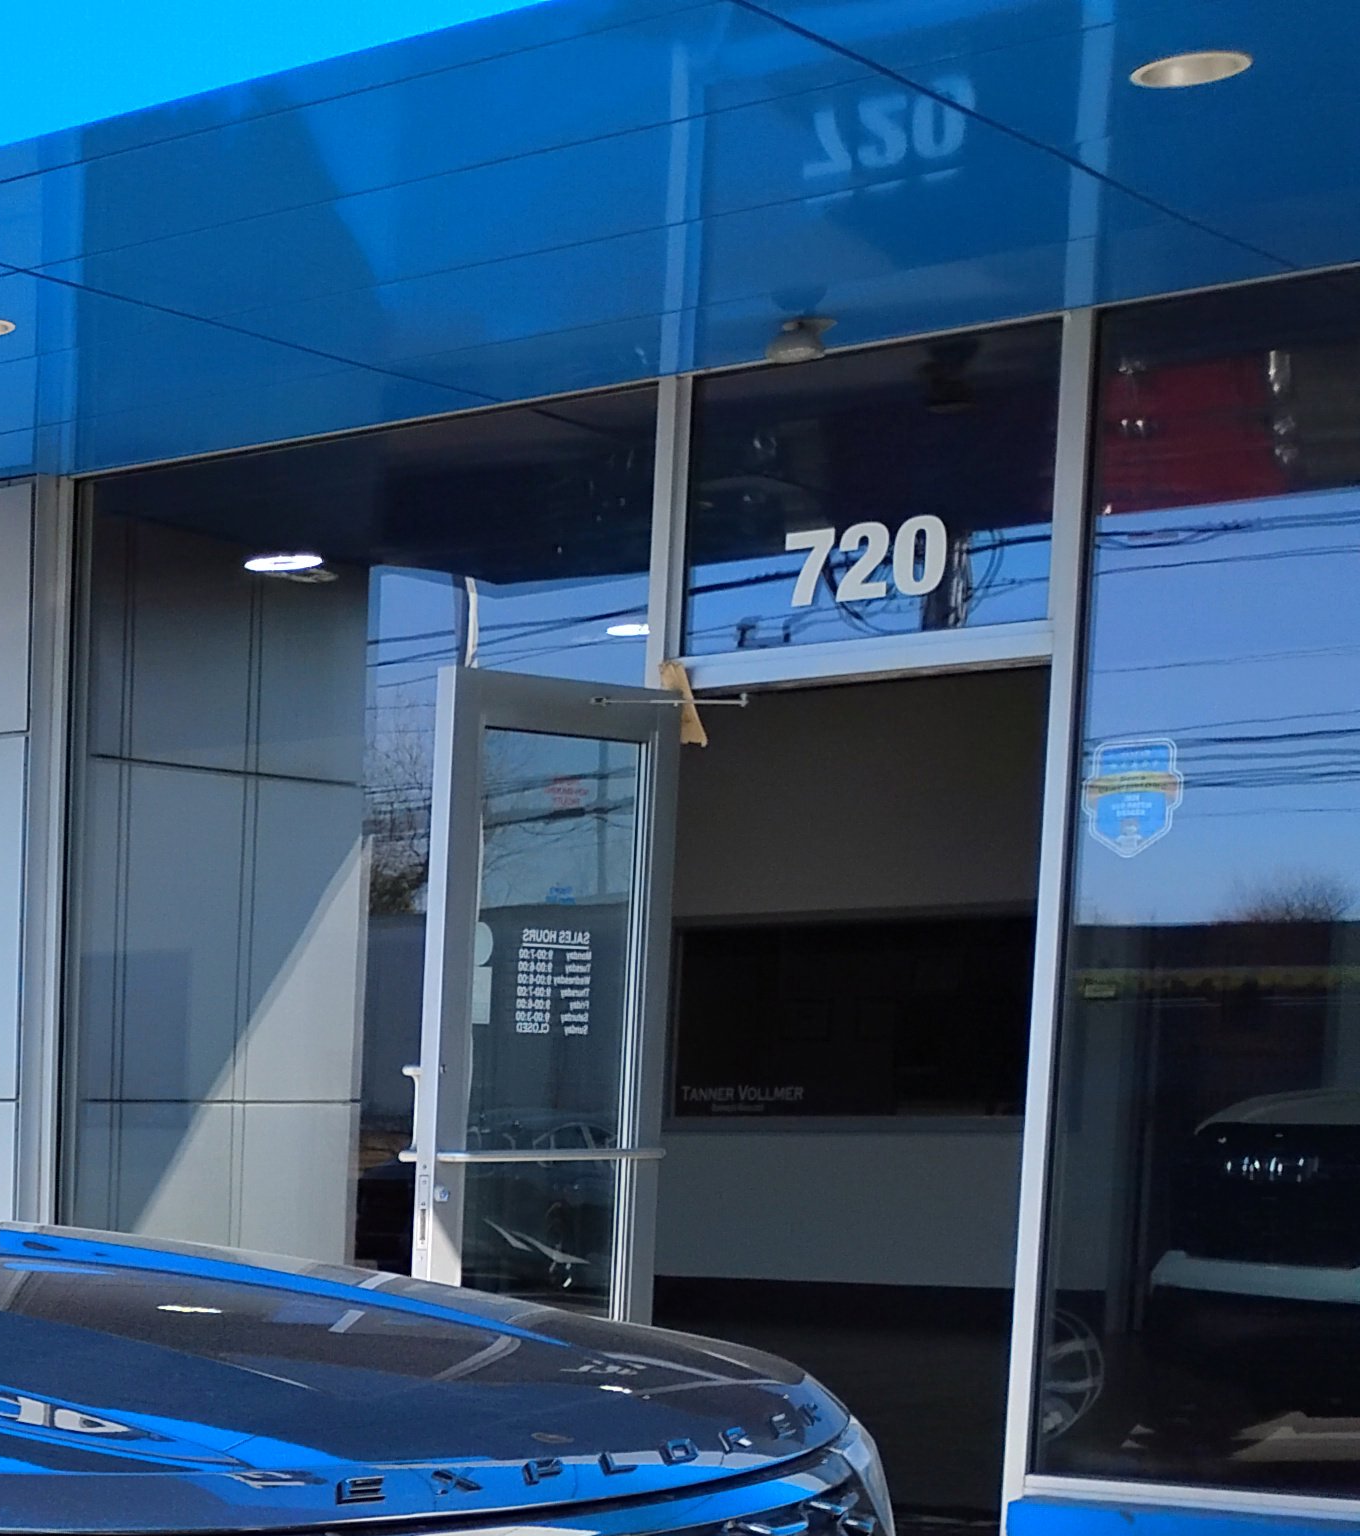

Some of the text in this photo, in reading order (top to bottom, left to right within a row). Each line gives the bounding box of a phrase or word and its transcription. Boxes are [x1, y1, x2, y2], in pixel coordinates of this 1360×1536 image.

[784, 513, 948, 609] 720
[680, 1084, 805, 1101] TANNER VOLLMER
